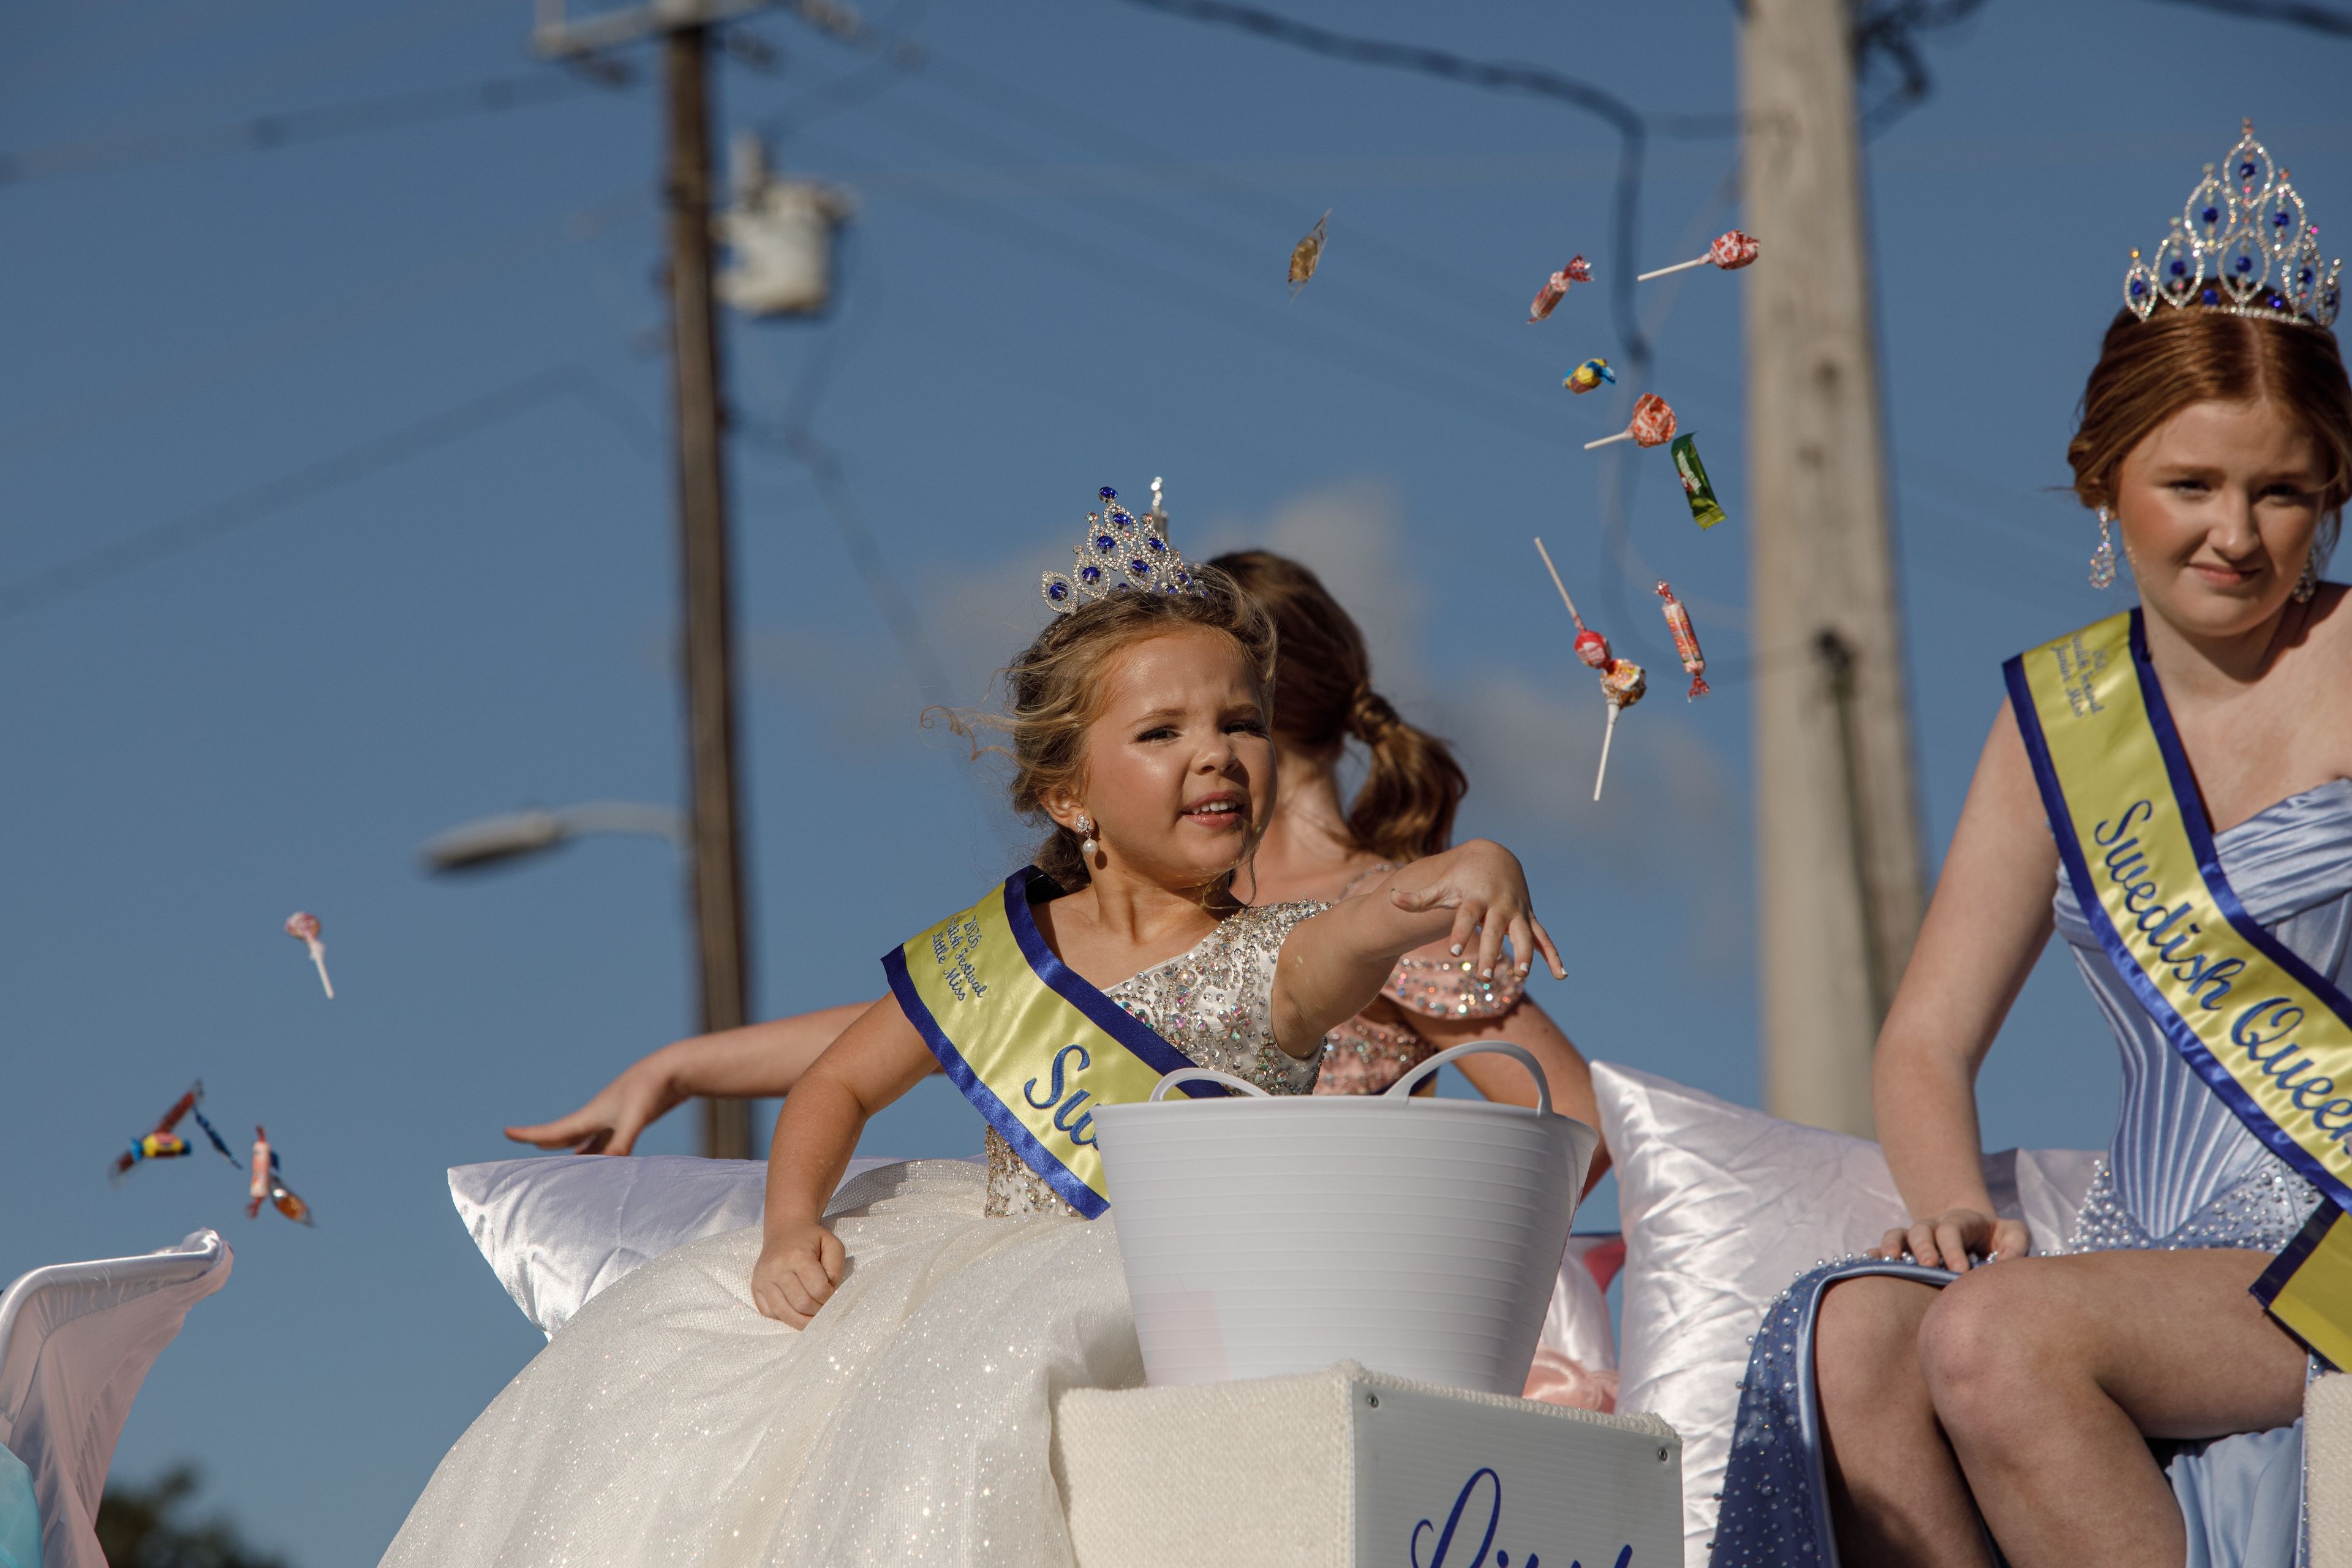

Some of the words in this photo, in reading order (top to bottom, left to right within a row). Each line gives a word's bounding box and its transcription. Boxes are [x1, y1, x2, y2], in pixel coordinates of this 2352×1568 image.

[2094, 799, 2245, 1011] Swedish
[932, 931, 949, 964] Little
[943, 967, 966, 1001] Miss
[955, 948, 987, 998] Festival
